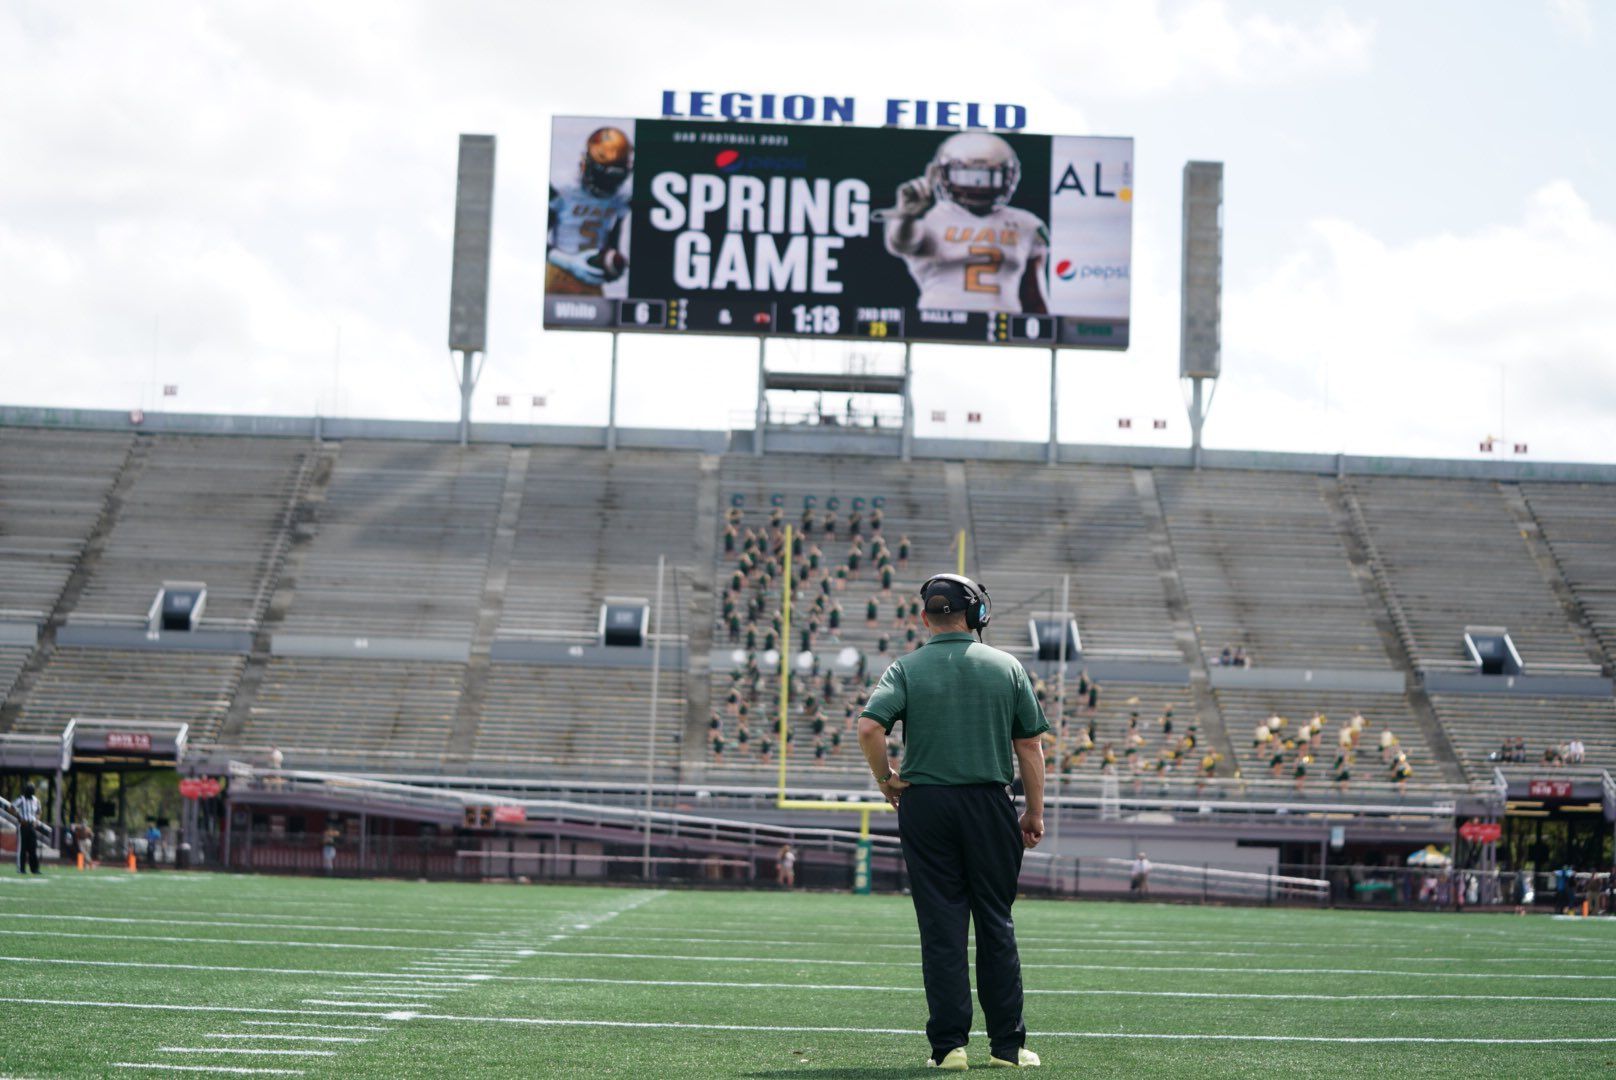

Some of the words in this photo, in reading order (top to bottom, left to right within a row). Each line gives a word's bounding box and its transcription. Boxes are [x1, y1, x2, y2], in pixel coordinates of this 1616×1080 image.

[662, 90, 855, 122] LEGION
[886, 99, 1026, 130] FIELD
[700, 133, 756, 145] FOOTBALL
[650, 171, 871, 237] SPRING
[945, 226, 1019, 246] UAB
[673, 231, 845, 293] GAME
[965, 245, 1002, 295] 2
[635, 303, 649, 324] 6
[792, 305, 840, 334] 1:13
[1025, 317, 1040, 339] 0
